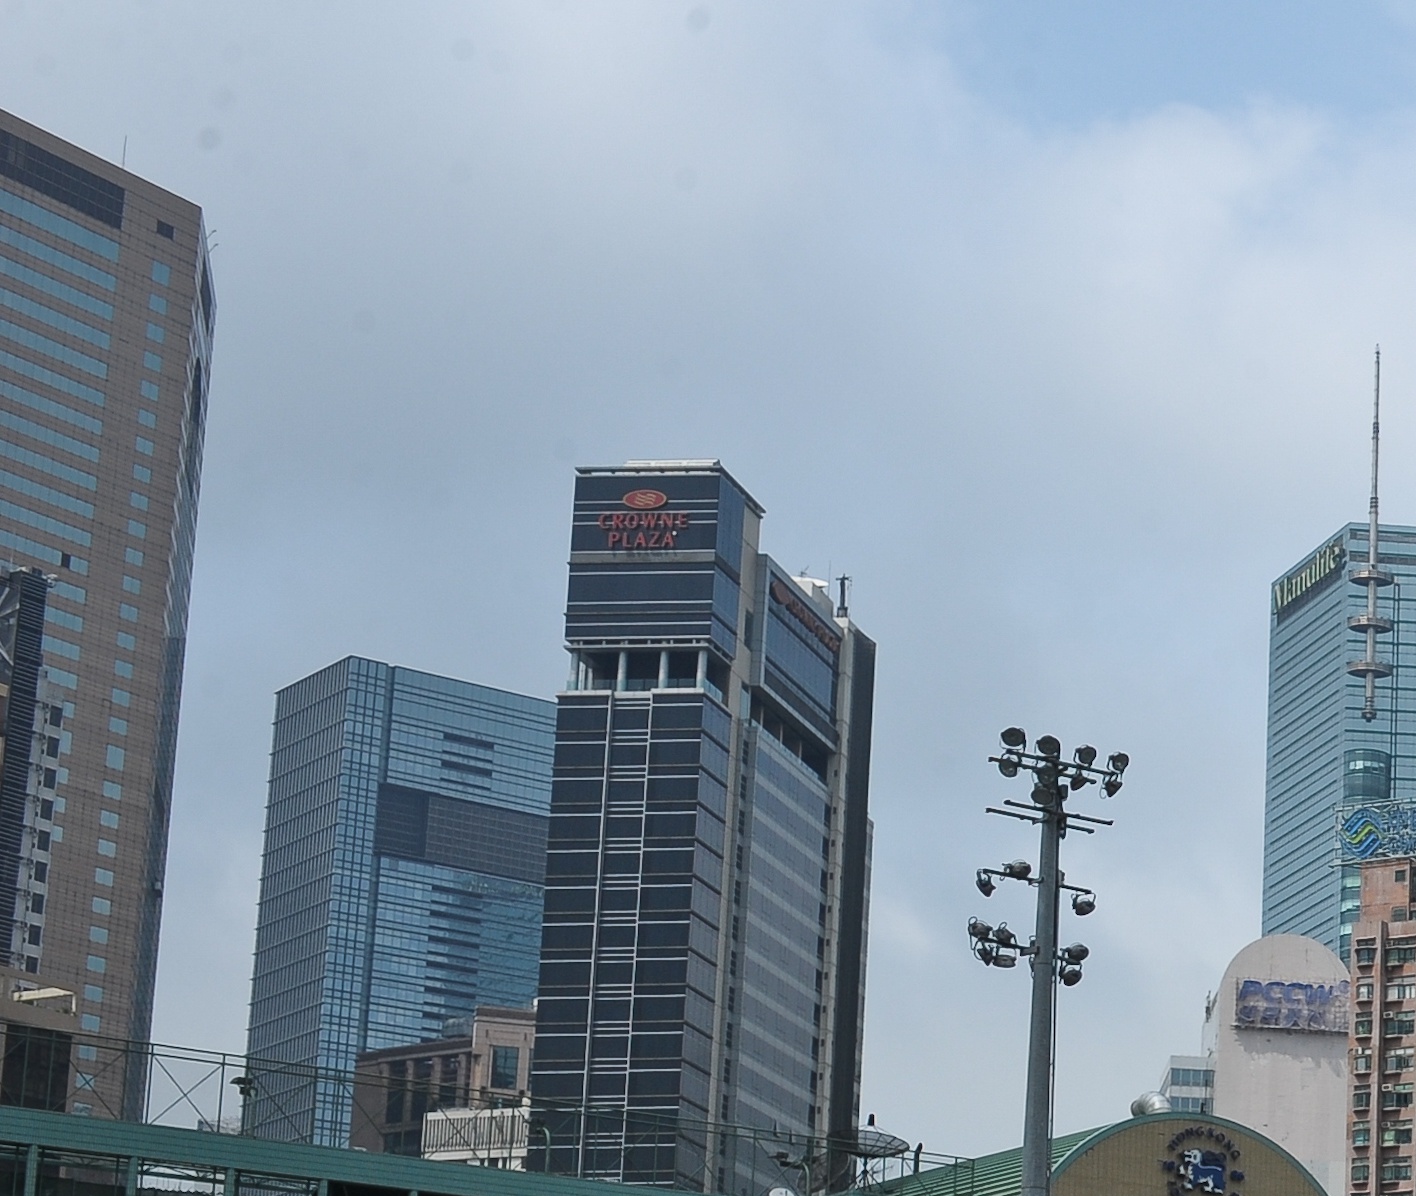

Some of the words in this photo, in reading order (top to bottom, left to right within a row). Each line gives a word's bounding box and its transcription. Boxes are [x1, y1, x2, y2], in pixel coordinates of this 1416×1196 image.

[598, 511, 688, 528] CROWNE
[608, 531, 674, 547] PLAZA
[1274, 542, 1340, 613] Manulife
[1239, 980, 1334, 1006] PCCW
